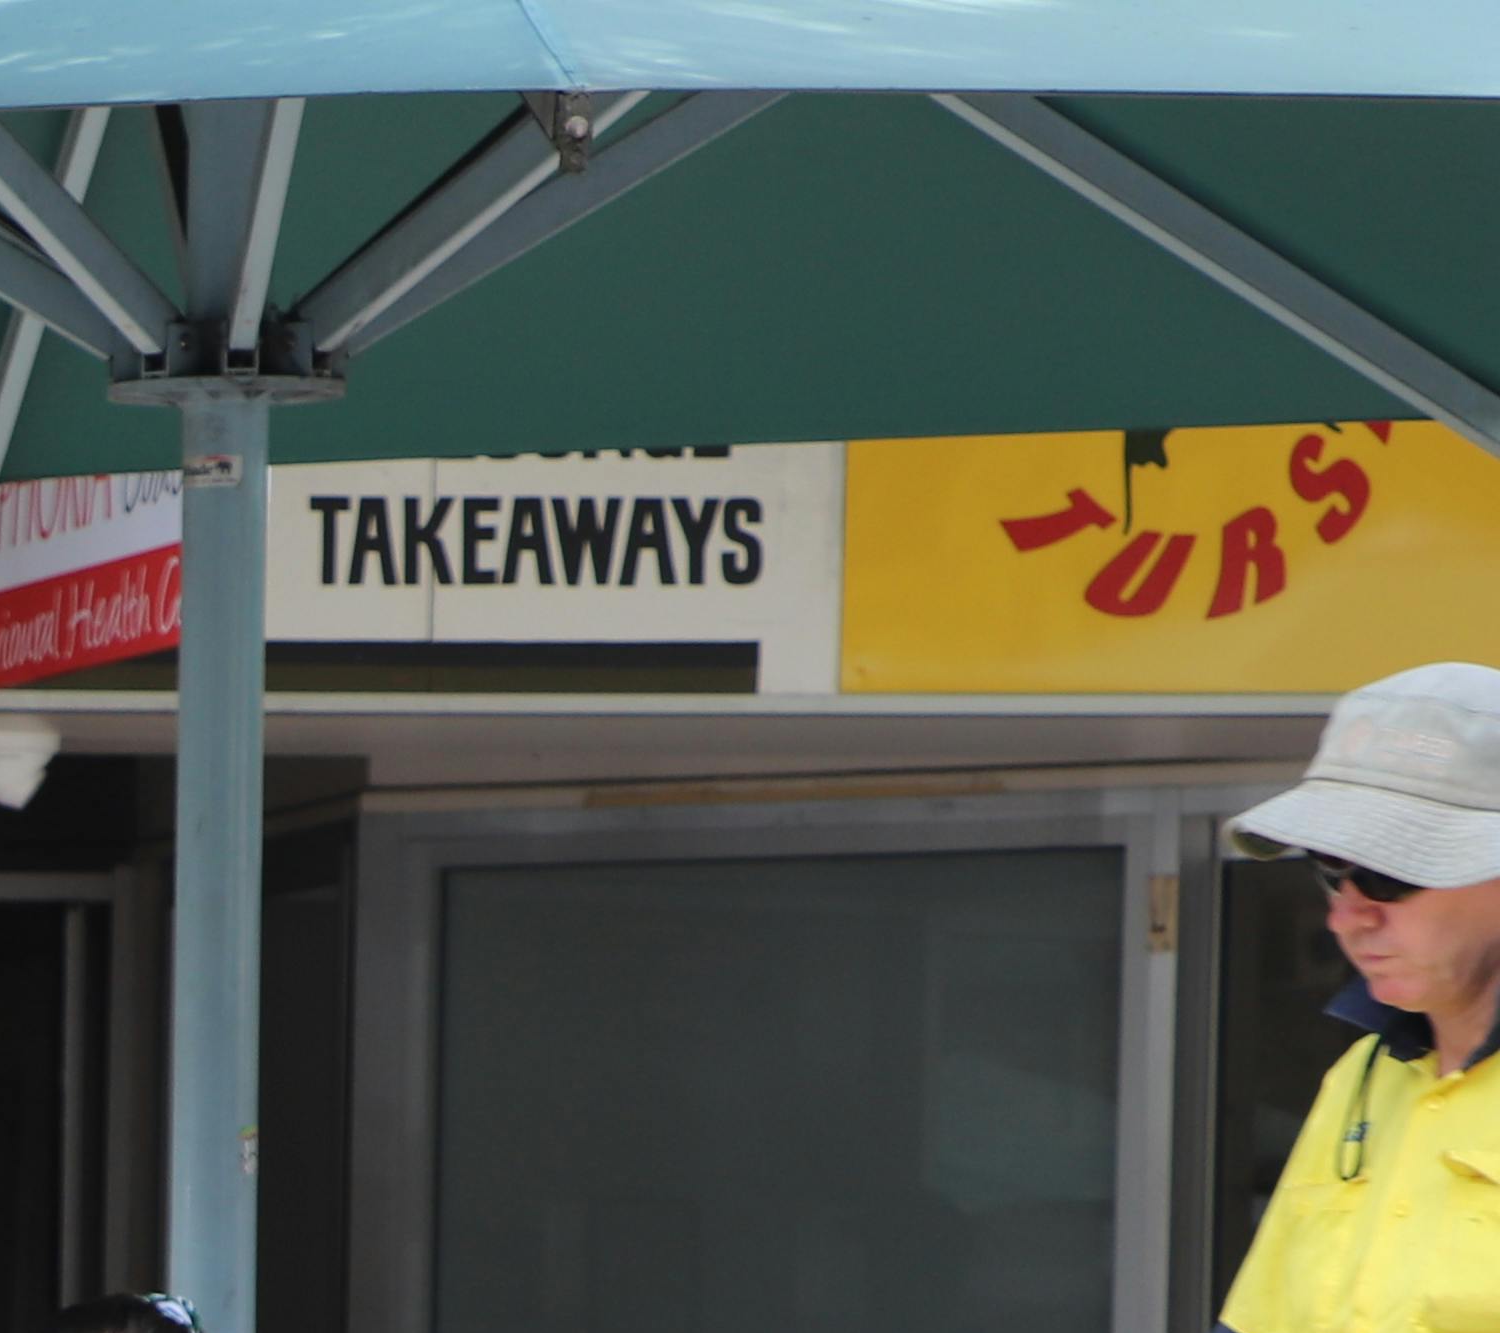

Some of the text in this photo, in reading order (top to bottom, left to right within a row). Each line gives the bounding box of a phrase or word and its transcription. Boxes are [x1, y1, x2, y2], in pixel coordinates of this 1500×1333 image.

[309, 496, 763, 587] TAKEAWAYS
[999, 421, 1392, 620] TURS
[65, 564, 152, 660] Health
